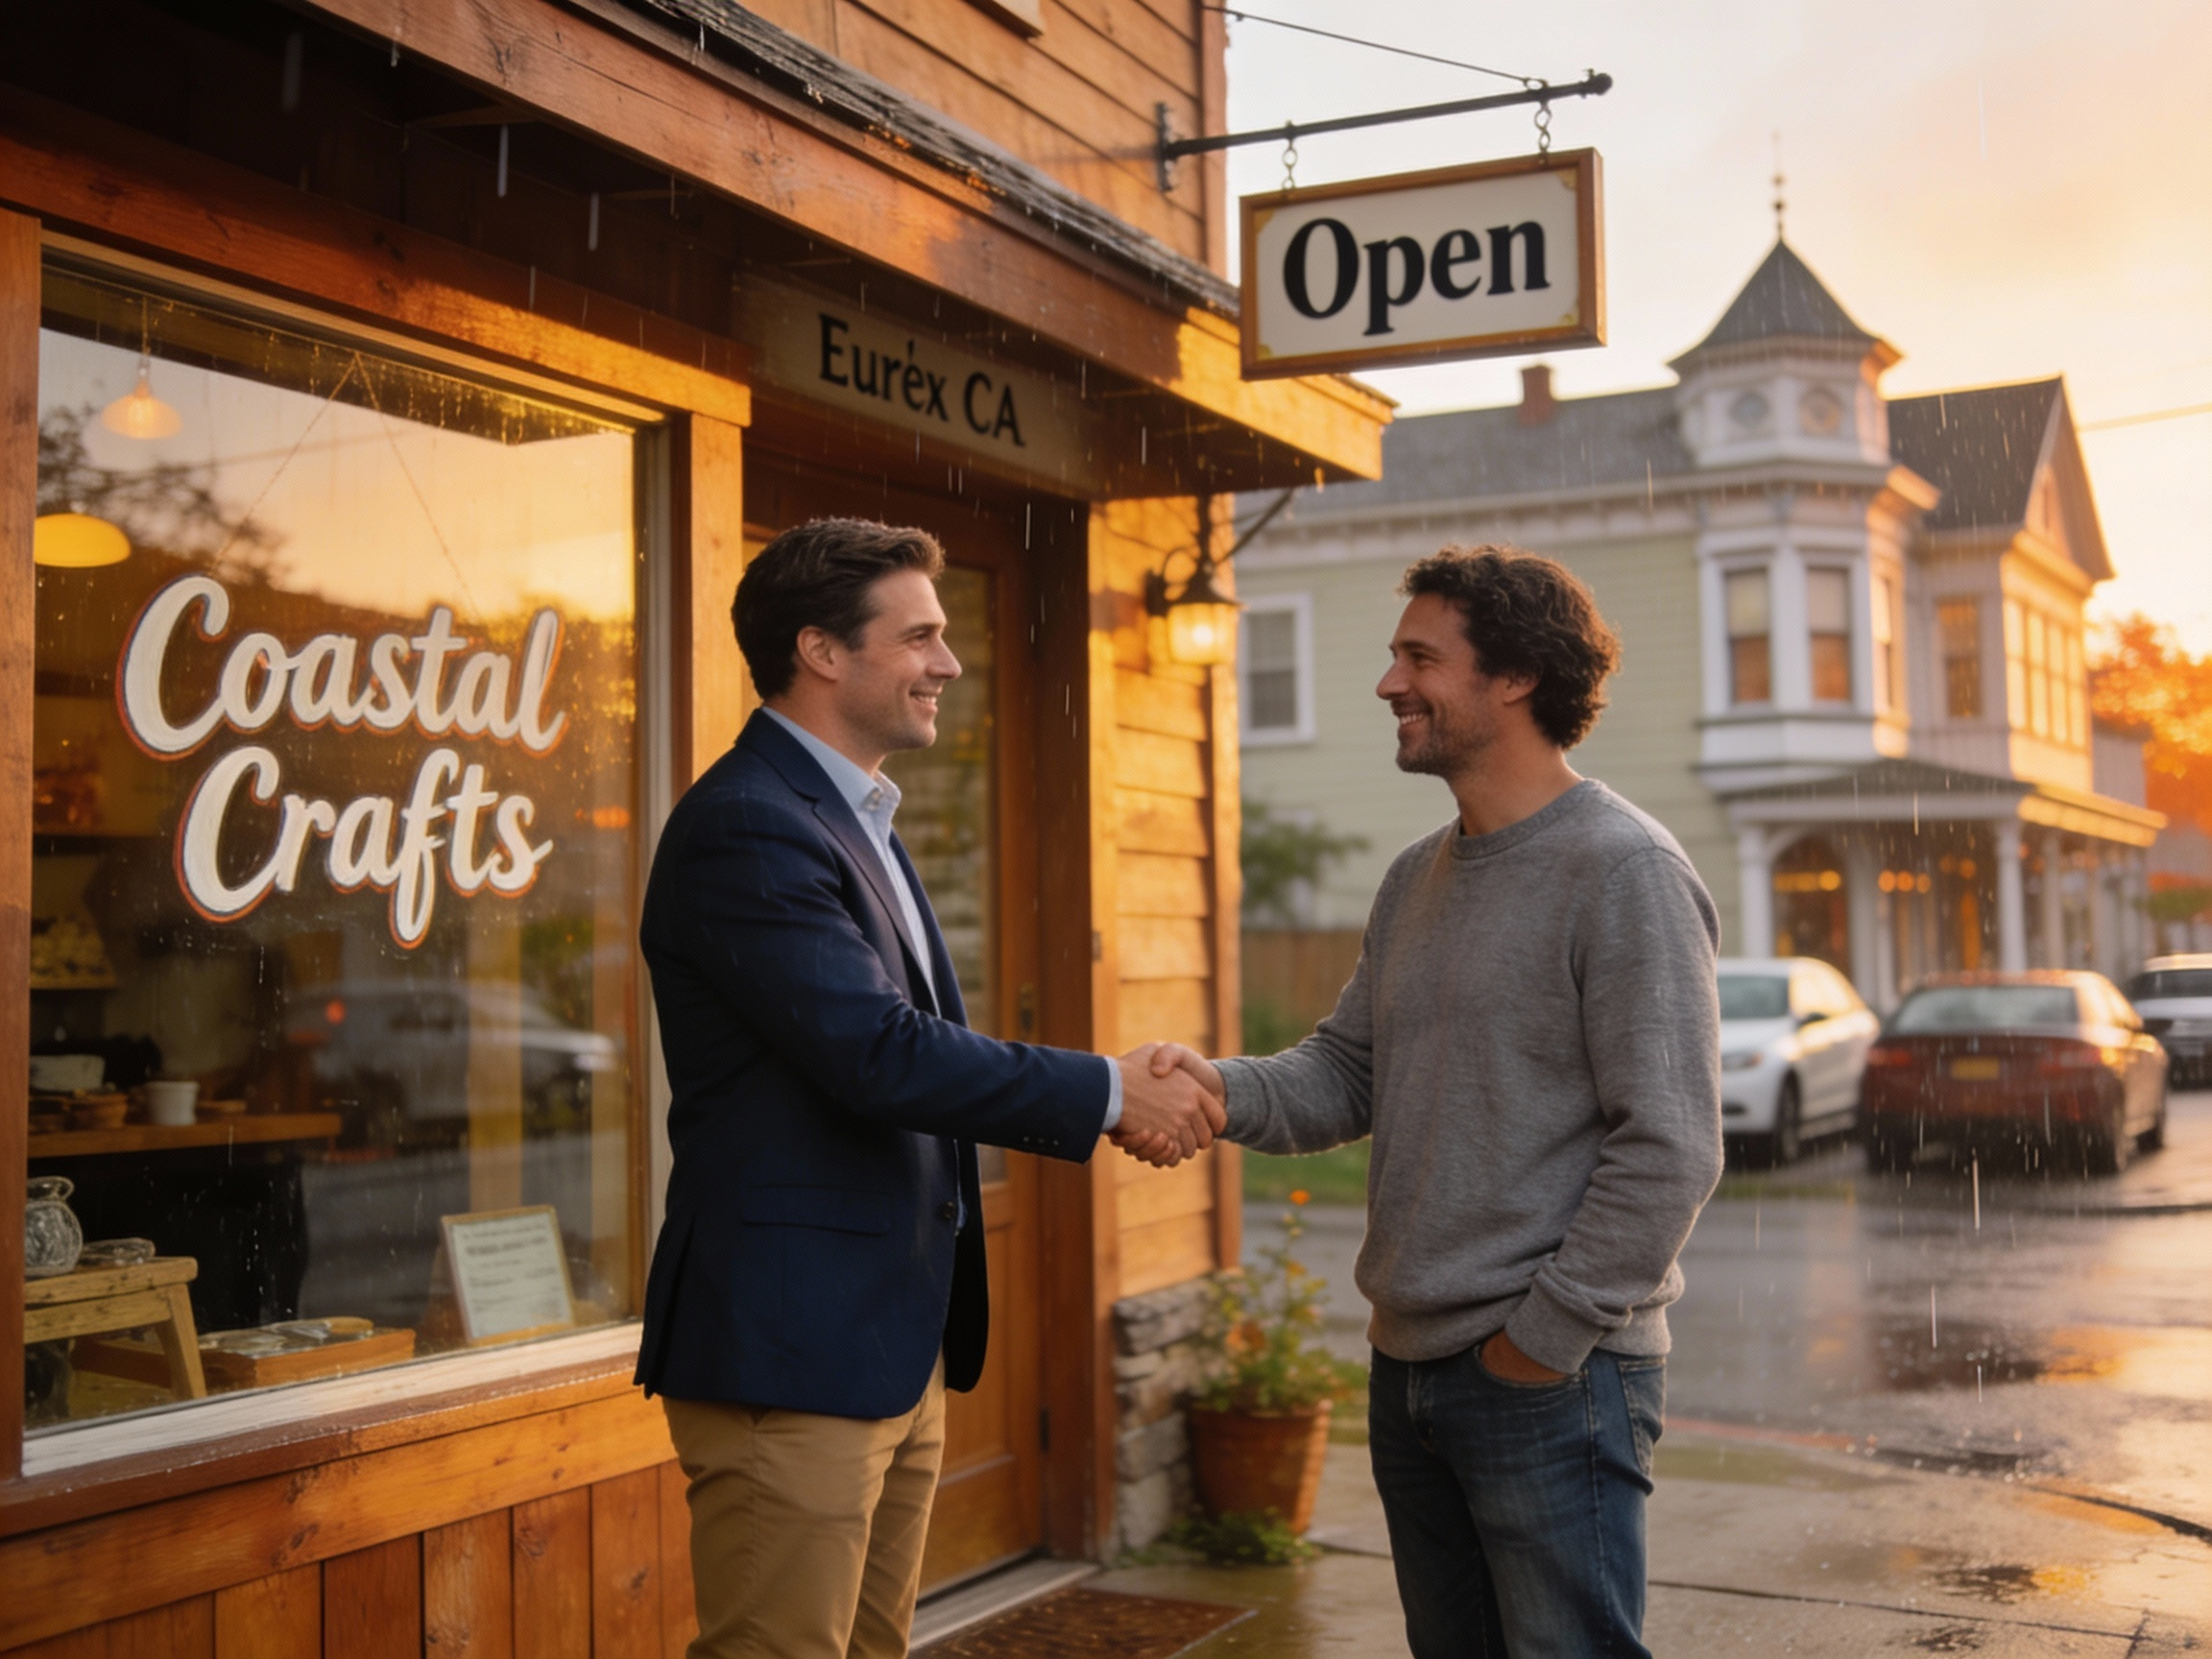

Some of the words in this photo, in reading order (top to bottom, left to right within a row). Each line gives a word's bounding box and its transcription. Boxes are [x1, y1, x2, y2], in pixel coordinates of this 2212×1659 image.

[1283, 217, 1551, 336] Open
[964, 372, 1025, 447] CA
[118, 574, 568, 757] Coastal
[176, 746, 553, 946] Crafts
